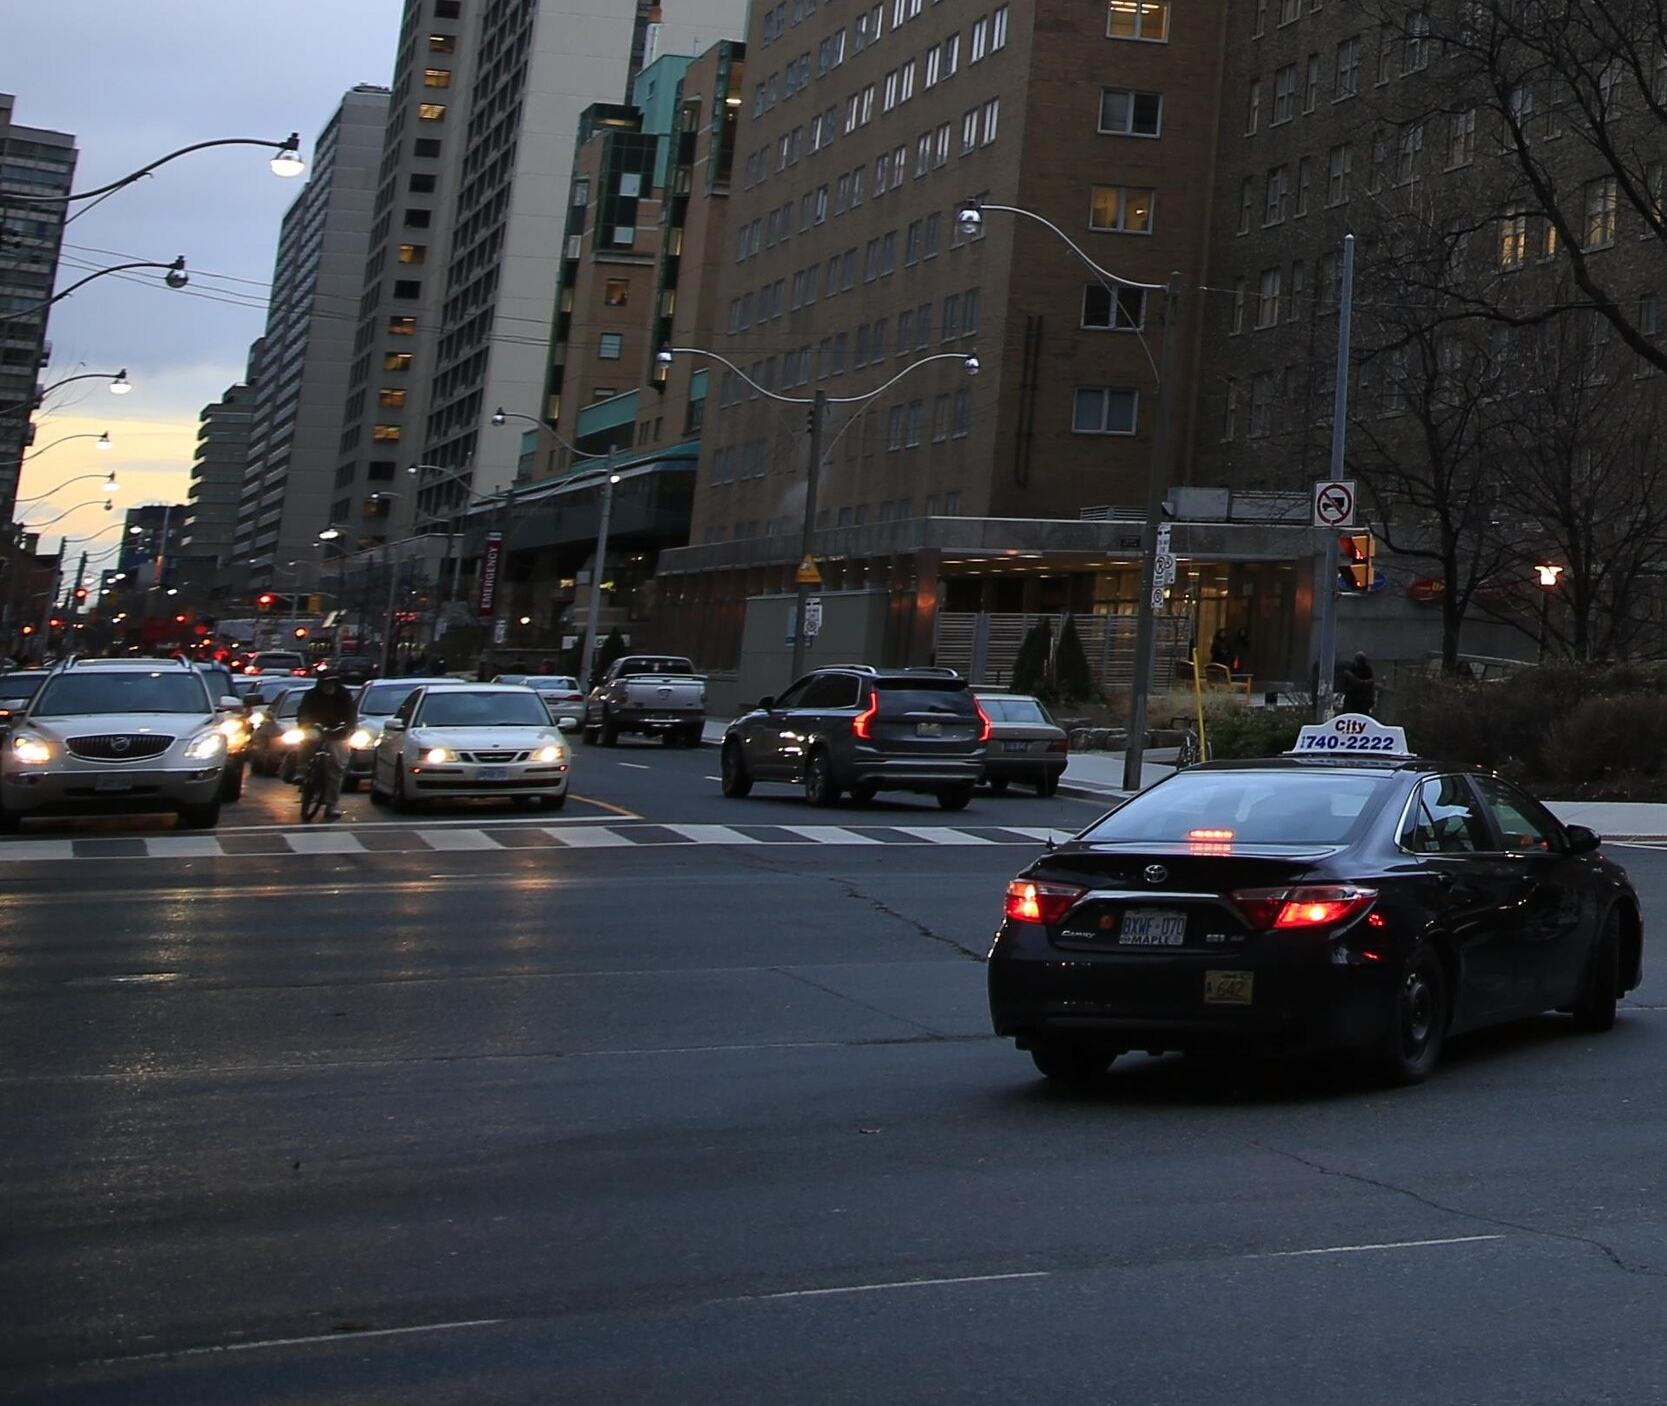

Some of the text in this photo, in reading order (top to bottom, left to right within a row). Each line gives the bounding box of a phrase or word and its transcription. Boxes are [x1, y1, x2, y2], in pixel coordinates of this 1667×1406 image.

[481, 546, 498, 608] EMERGENCY
[1335, 720, 1367, 734] City
[1306, 736, 1394, 750] 740-2222
[1123, 917, 1185, 935] BXWF 070
[1132, 935, 1170, 944] MAPLE
